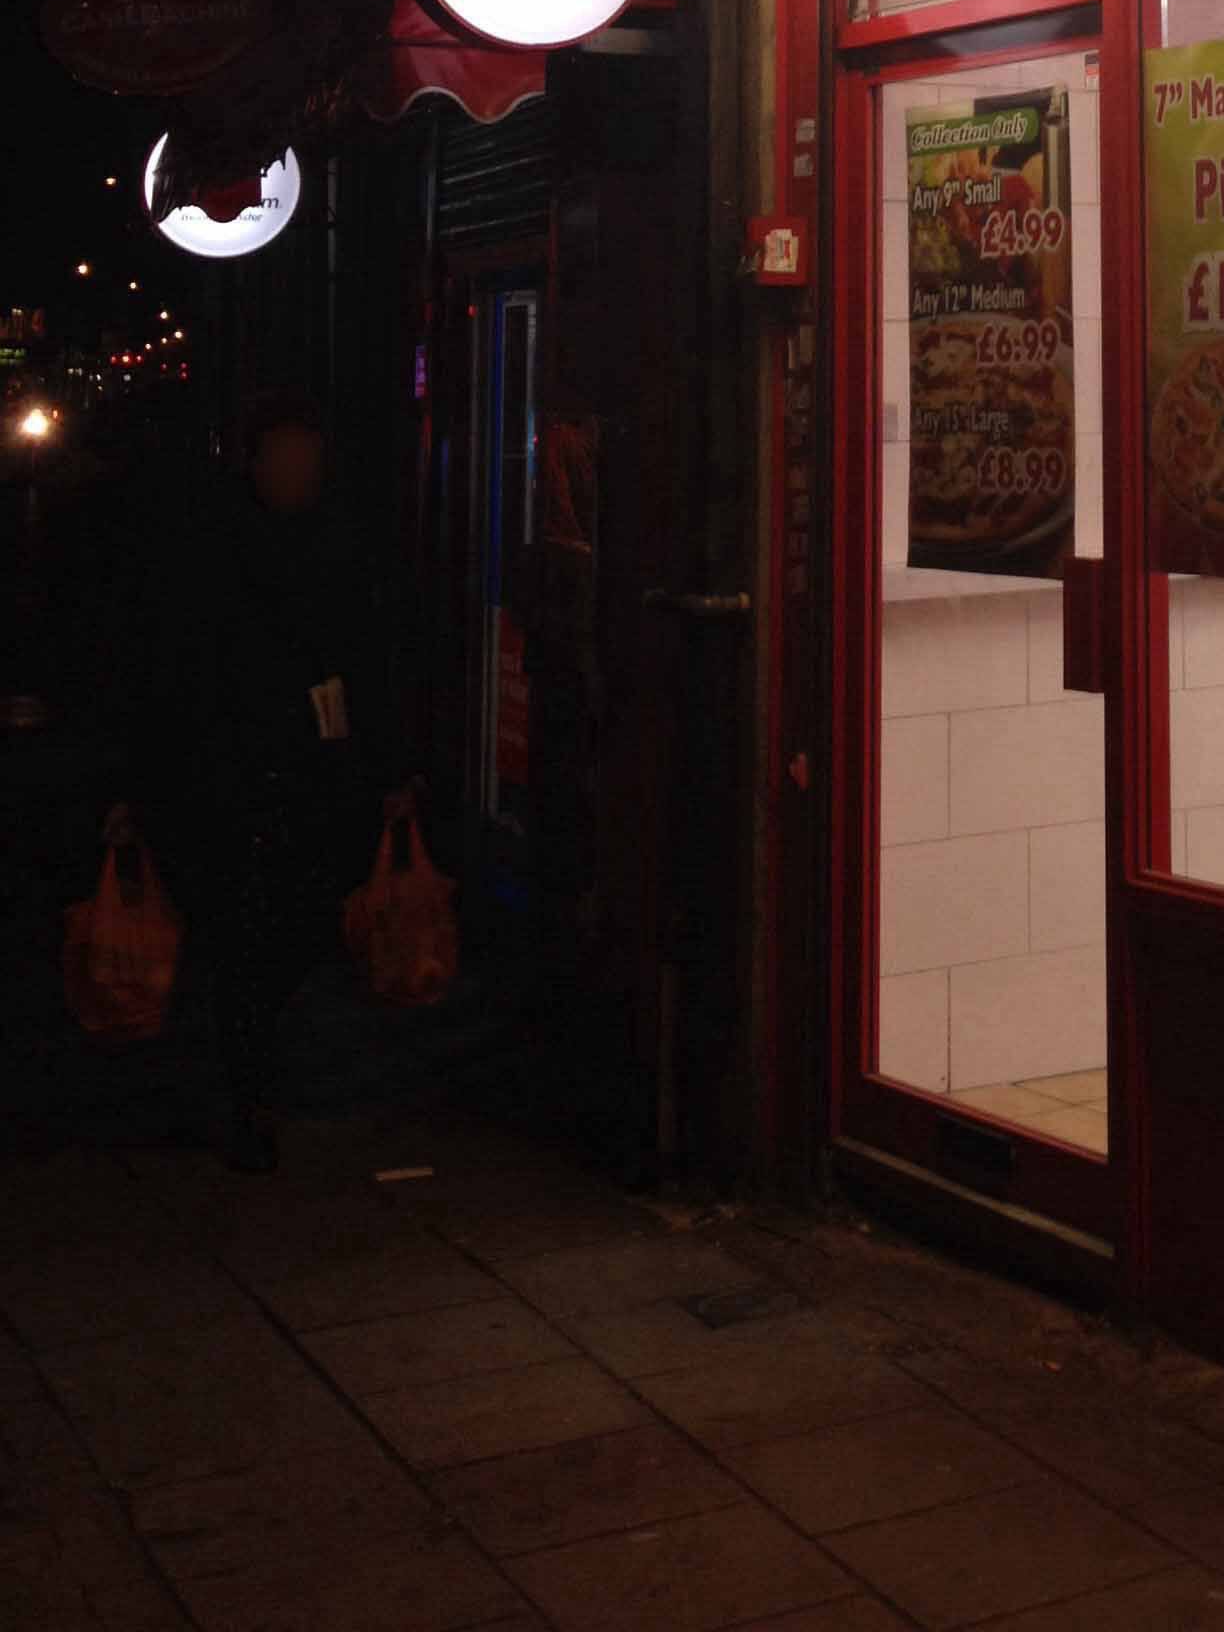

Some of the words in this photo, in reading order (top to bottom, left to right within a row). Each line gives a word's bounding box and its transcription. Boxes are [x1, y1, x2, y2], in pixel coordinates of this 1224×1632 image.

[911, 120, 990, 151] Collection
[991, 112, 1029, 143] Only
[913, 185, 940, 217] Any
[964, 175, 1001, 207] Small
[980, 208, 1065, 259] £4.99
[913, 287, 939, 320] Any
[969, 282, 1026, 311] Medium
[977, 446, 1066, 495] £8.99
